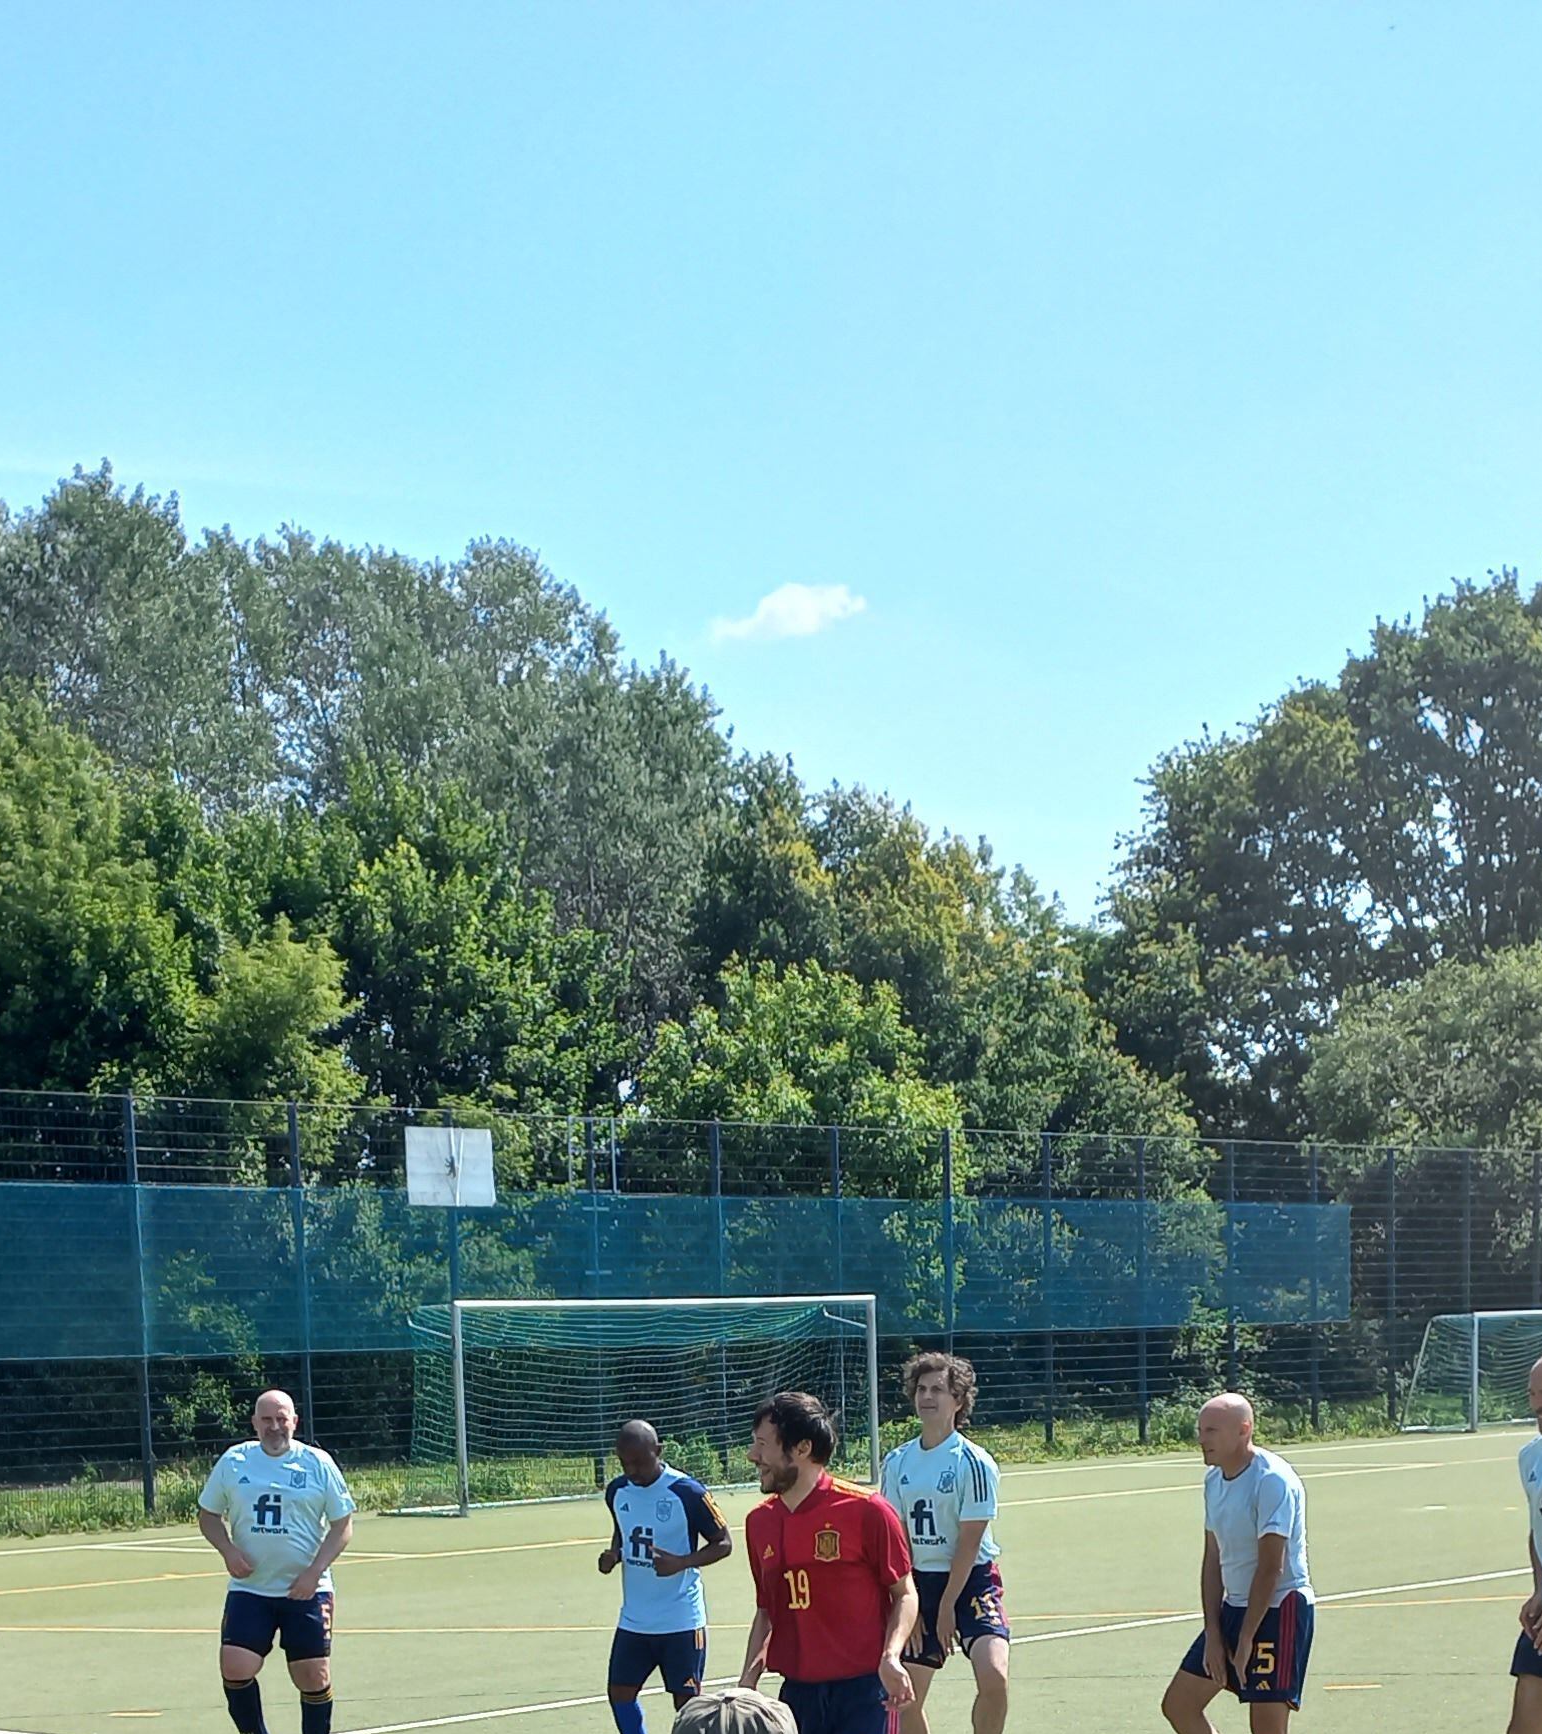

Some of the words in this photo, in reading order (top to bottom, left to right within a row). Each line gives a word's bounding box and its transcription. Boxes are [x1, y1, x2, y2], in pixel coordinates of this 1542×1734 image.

[253, 1494, 281, 1525] fi
[910, 1499, 936, 1536] fi
[783, 1569, 810, 1609] 19
